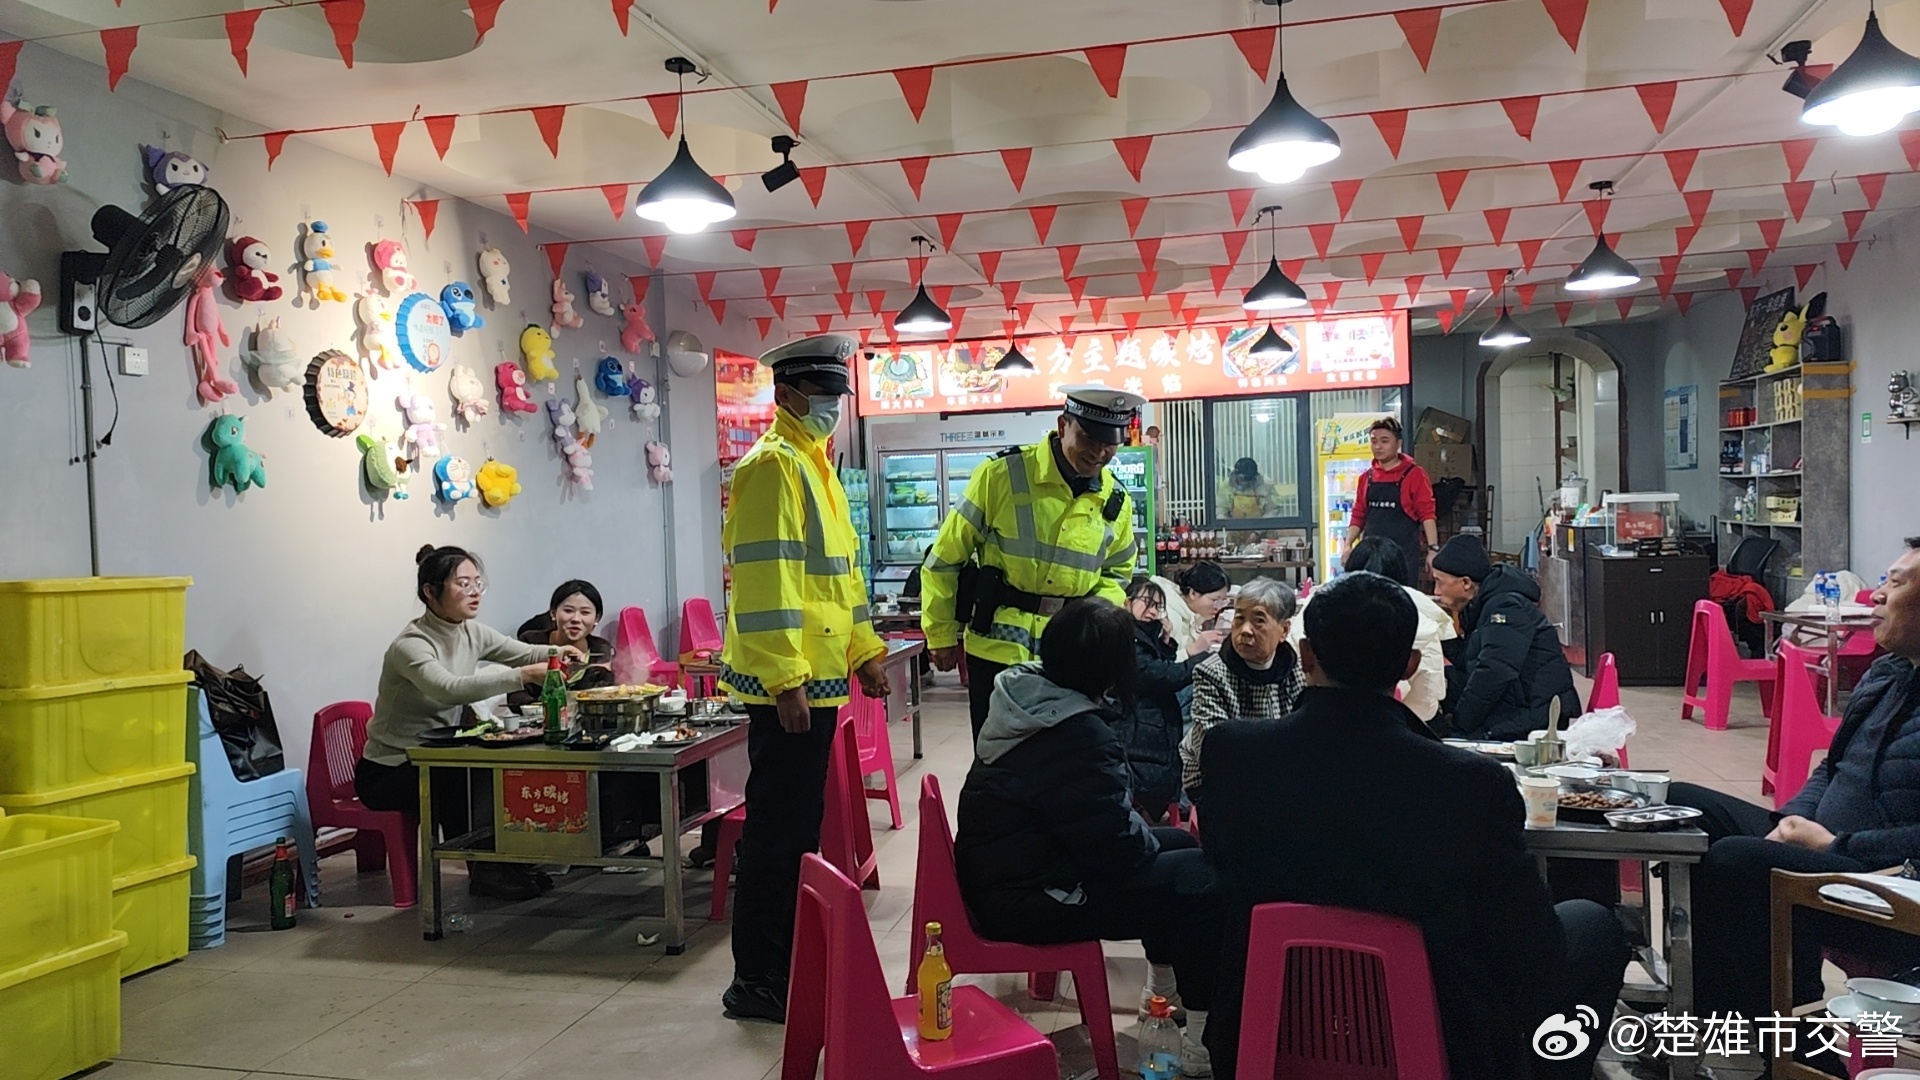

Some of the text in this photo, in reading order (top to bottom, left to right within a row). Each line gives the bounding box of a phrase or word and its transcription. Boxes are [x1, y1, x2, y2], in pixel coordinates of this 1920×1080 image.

[1048, 373, 1182, 399] 欢光临
[521, 784, 569, 805] 东方碳烤
